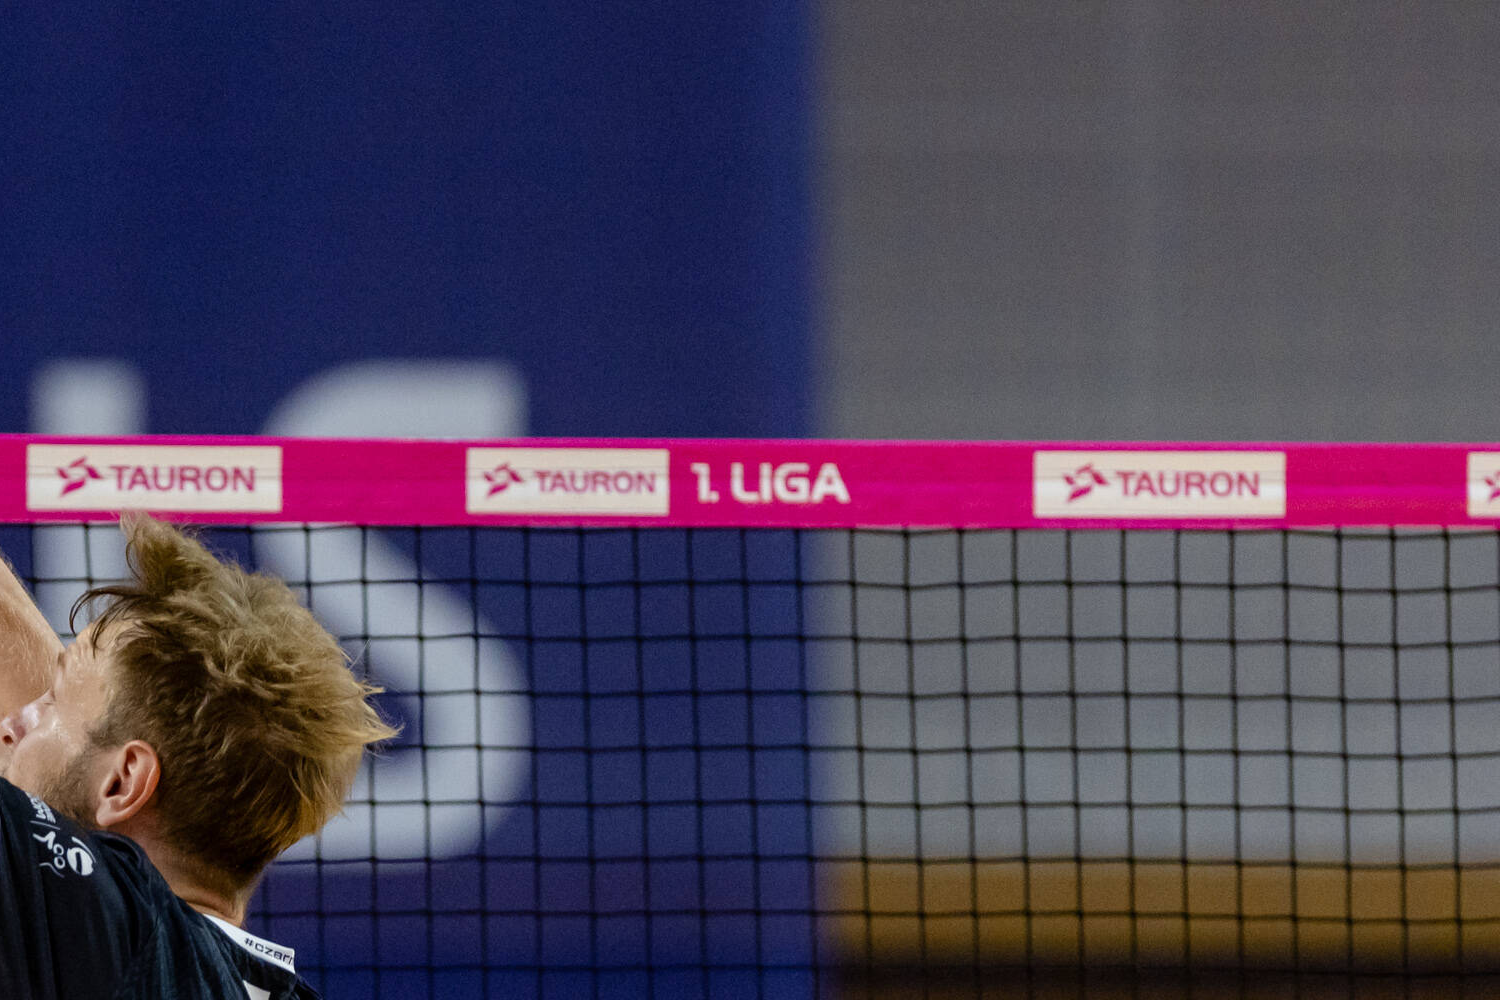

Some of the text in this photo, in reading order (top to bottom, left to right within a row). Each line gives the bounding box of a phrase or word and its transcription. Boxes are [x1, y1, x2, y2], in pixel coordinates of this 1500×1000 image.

[108, 465, 256, 492] TAURON
[533, 470, 655, 493] TAURON
[690, 462, 851, 503] 1. LIGA
[1117, 470, 1260, 498] TAURON
